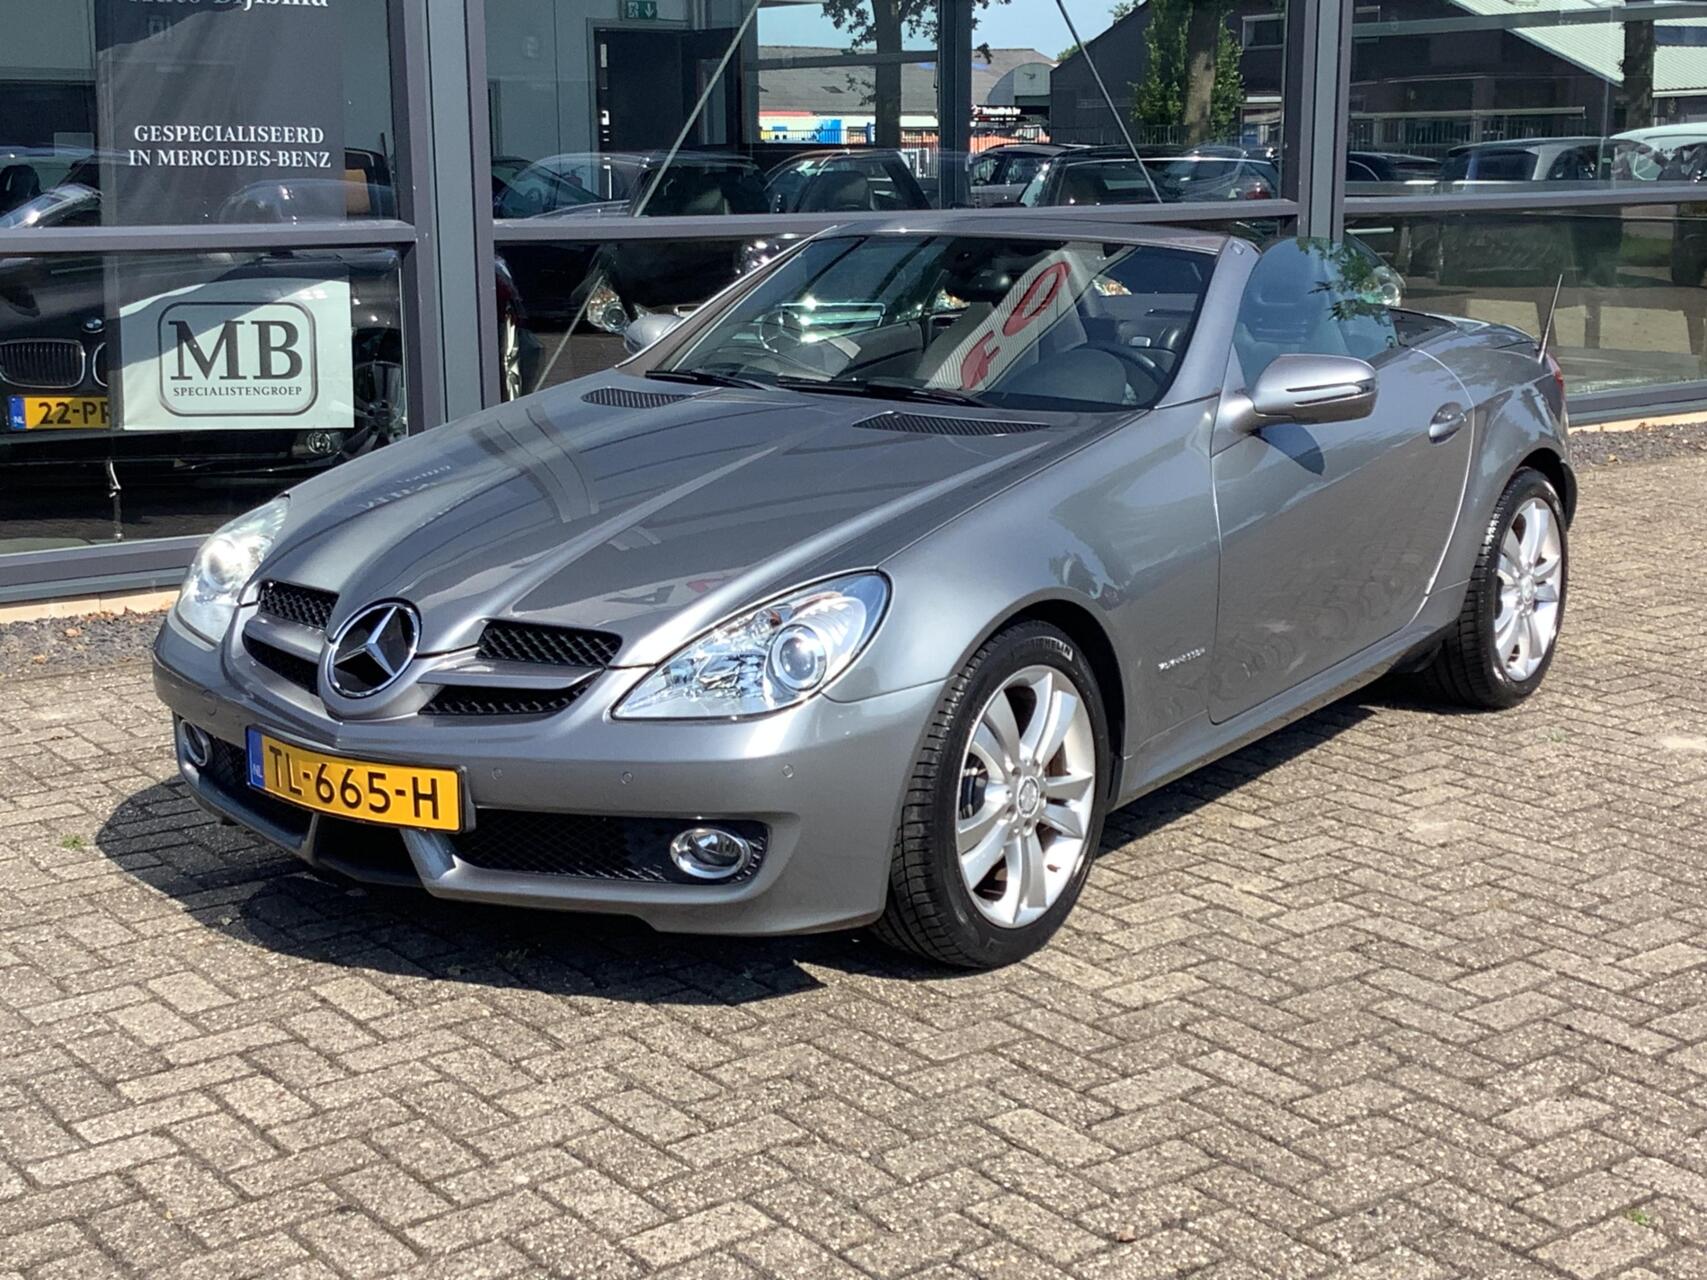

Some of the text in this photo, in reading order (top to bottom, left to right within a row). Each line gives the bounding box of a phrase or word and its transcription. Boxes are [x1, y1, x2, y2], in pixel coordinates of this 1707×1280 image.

[134, 125, 324, 143] GESPECIALISEERD
[128, 149, 331, 168] IN MERCEDES-BENZ
[168, 320, 303, 380] MB
[173, 386, 302, 397] SPECIALISTENGROEP
[269, 745, 440, 820] TL-665-H
